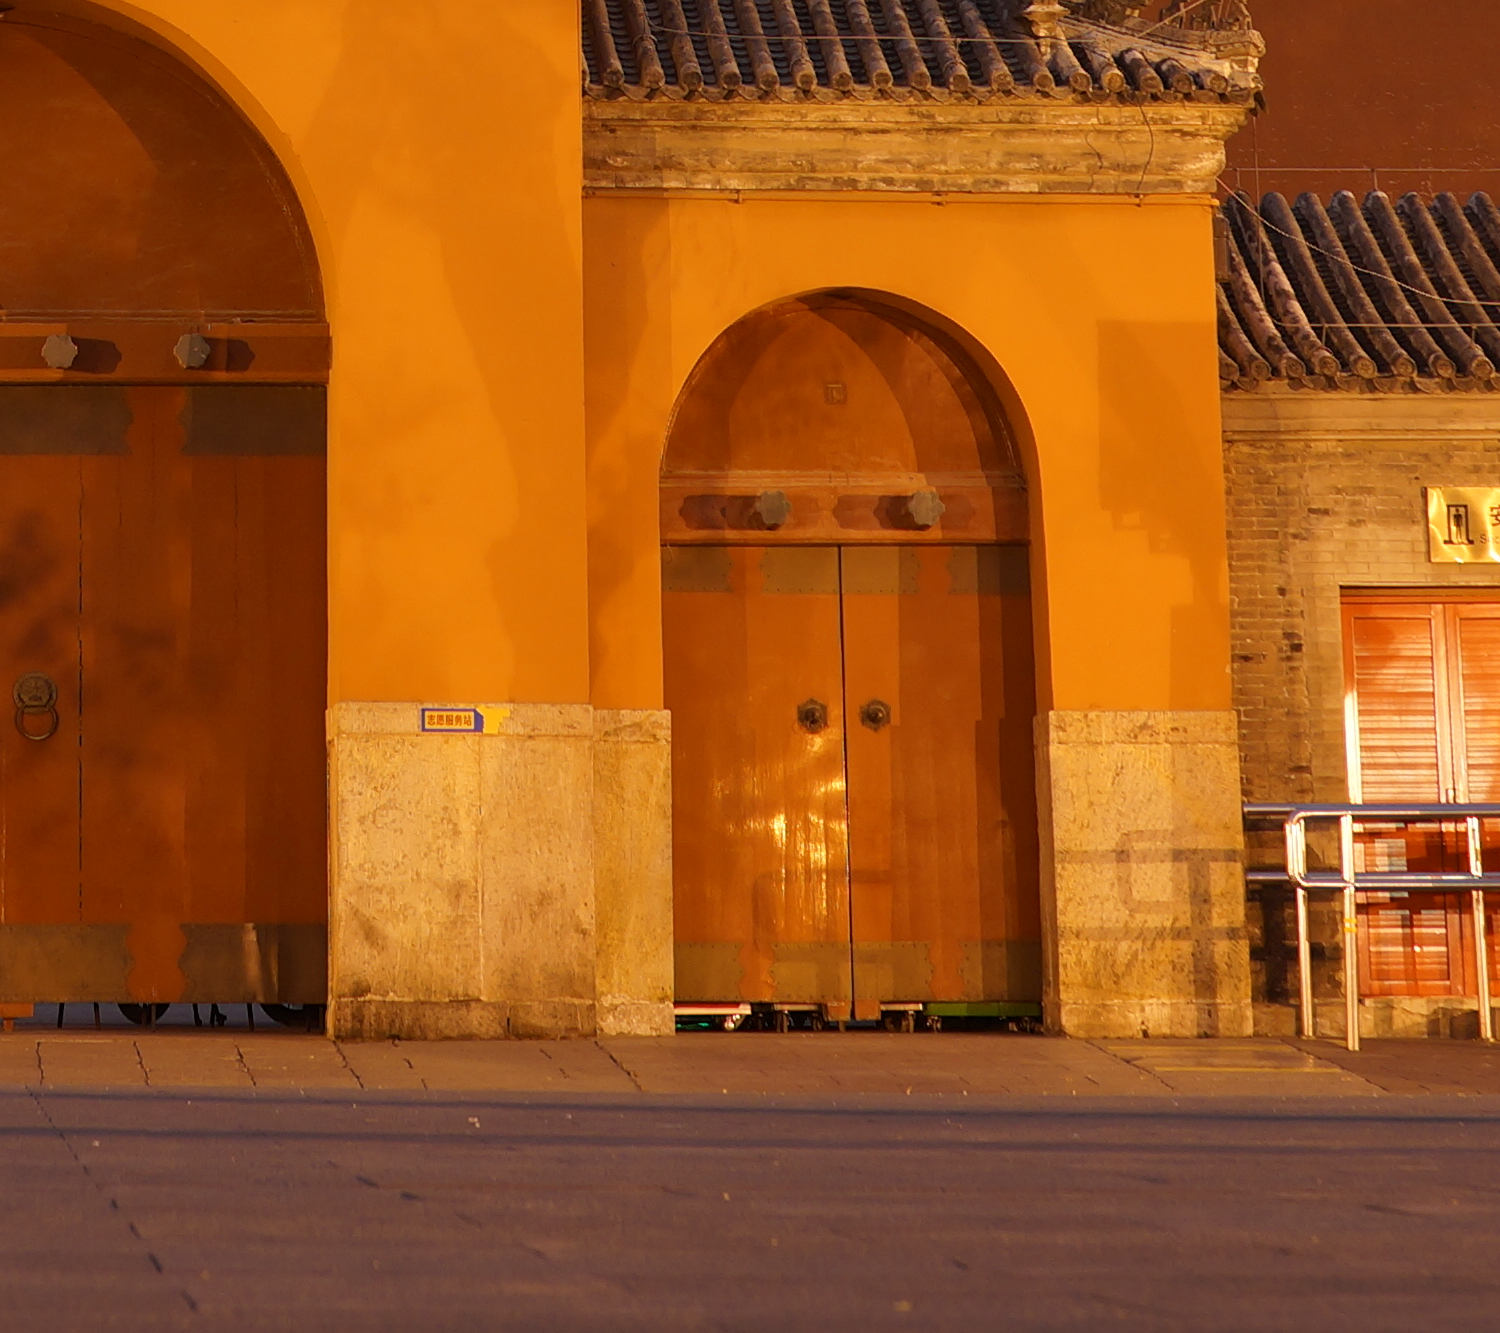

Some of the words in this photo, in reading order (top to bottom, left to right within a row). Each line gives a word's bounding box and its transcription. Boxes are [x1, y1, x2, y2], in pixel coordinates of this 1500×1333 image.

[427, 714, 472, 727] 志愿服务站
